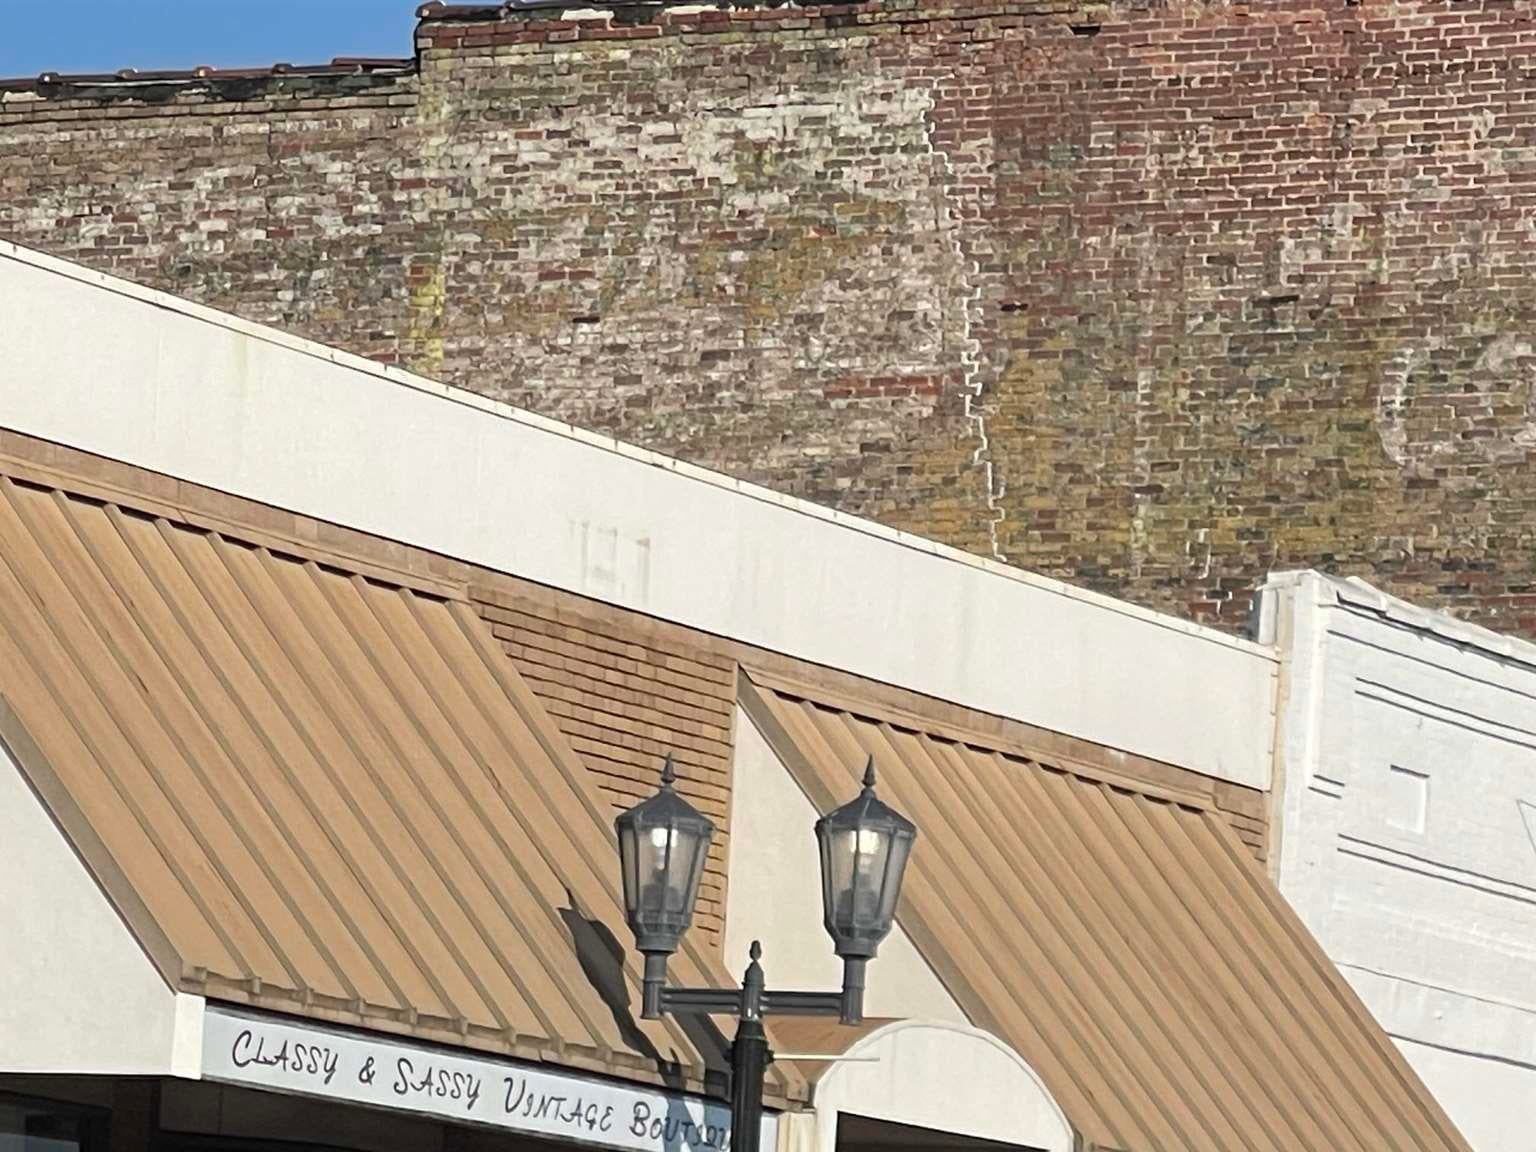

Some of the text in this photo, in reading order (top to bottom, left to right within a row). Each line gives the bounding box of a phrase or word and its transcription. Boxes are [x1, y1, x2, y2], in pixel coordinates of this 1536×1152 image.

[232, 1030, 731, 1152] CLASSY & SASSY VINTAGE BOUTIQU
